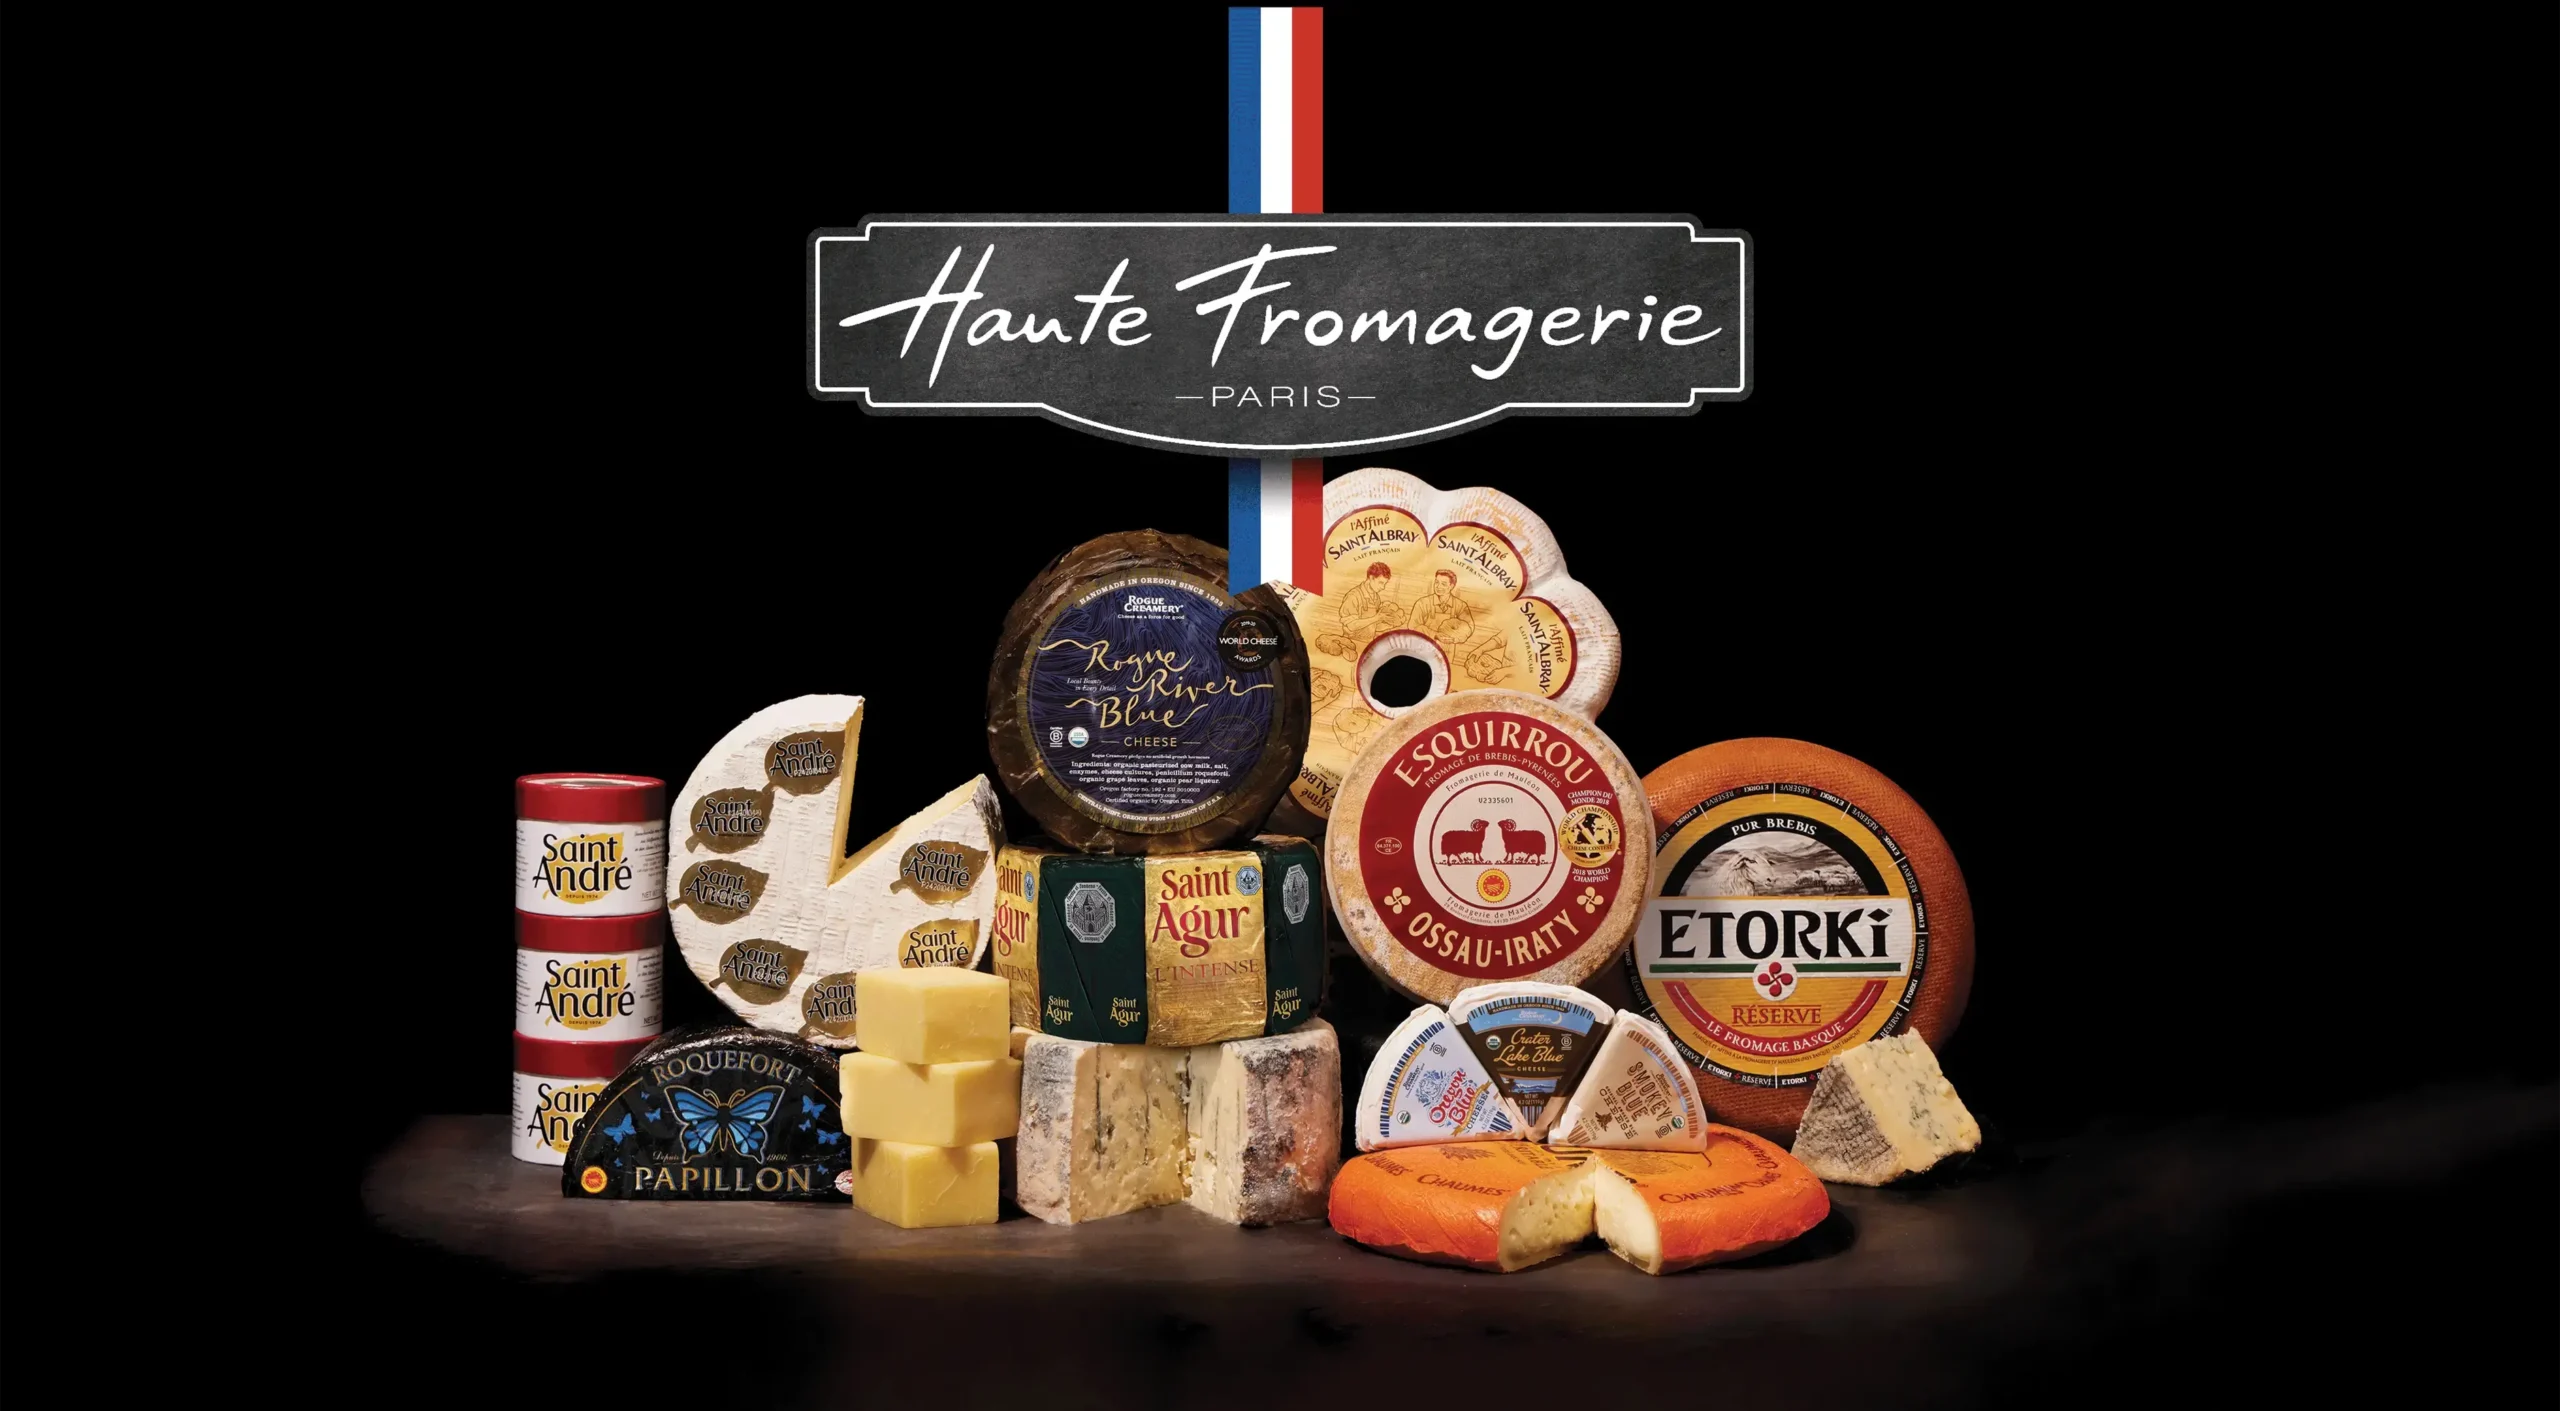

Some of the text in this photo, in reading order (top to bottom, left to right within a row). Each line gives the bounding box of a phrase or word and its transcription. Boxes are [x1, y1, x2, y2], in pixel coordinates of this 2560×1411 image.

[1350, 514, 1390, 531] l'Affiné
[1328, 529, 1419, 560] SAINT ALBRAY
[1353, 553, 1367, 562] LAIT
[1471, 533, 1508, 561] l'Affiné
[1438, 535, 1517, 589] SAINT ALBRAY
[1451, 558, 1465, 568] LAIT
[1079, 580, 1125, 605] HANDMADE
[1127, 578, 1138, 586] IN
[1140, 577, 1177, 586] OREGON
[1178, 582, 1205, 596] SINCE
[1128, 595, 1164, 606] ROGUE
[1124, 602, 1181, 613] CREAMERY
[1219, 637, 1278, 646] WORLD CHEESE
[1520, 601, 1552, 693] SAINT ALBRAY
[1549, 624, 1567, 663] l'Affiné
[1038, 639, 1194, 683] Rogue
[1234, 654, 1262, 663] AWARDS
[1126, 668, 1274, 703] River
[1065, 694, 1209, 728] Blue
[775, 738, 824, 757] Saint
[1124, 737, 1177, 748] CHEESE
[1393, 720, 1593, 788] ESQUIRROU
[769, 749, 836, 777] André
[1071, 761, 1112, 769] Ingredients:
[1424, 758, 1466, 788] FROMAGE
[1468, 753, 1481, 762] DE
[1300, 764, 1335, 795] ALBR
[1445, 769, 1541, 792] Fromagerie de Mauléon
[705, 797, 752, 815] Saint
[1299, 788, 1332, 813] Affiné
[1567, 790, 1613, 800] CHAMPION DU
[1571, 797, 1610, 805] MONDE 2018
[1561, 806, 1619, 836] WORLD CHAMPIONSHIP
[1731, 818, 1817, 836] PUR BREBIS
[543, 833, 618, 862] Saint
[916, 844, 963, 868] Saint
[532, 855, 632, 897] André
[698, 865, 745, 890] Saint
[903, 857, 970, 887] André
[999, 859, 1023, 898] aint
[1161, 865, 1231, 901] Saint
[1573, 874, 1609, 883] CHAMPION
[1587, 867, 1610, 876] WORLD
[685, 877, 752, 910] André
[1446, 896, 1491, 919] Fromagerie
[1508, 896, 1541, 917] Mauléon
[1916, 902, 1925, 928] ETORKI
[910, 929, 957, 949] Saint
[993, 900, 1029, 957] gur
[1152, 902, 1250, 958] Agur
[1408, 908, 1579, 968] OSSAU-IRATY
[736, 942, 782, 969] Saint
[903, 941, 968, 968] André
[546, 959, 621, 988] Saint
[722, 954, 789, 986] André
[1154, 959, 1260, 982] L'INTENSE
[535, 981, 635, 1024] André
[814, 980, 857, 999] Sain
[1048, 995, 1070, 1009] Saint
[1275, 987, 1298, 1001] Saint
[1903, 979, 1919, 1004] ETORKI
[807, 997, 857, 1023] And
[1046, 1004, 1073, 1025] Agur
[1112, 997, 1137, 1009] Saint
[1272, 999, 1301, 1020] Agur
[1732, 1004, 1822, 1026] RÉSERVE
[1110, 1007, 1141, 1028] Agur
[1511, 1028, 1551, 1045] Crater
[1706, 1021, 1721, 1037] LE
[1724, 1031, 1790, 1053] FROMAGE
[1793, 1022, 1845, 1050] BASQUE
[650, 1050, 803, 1085] ROQUEFORT
[1494, 1045, 1563, 1067] Lake Blue
[1707, 1064, 1732, 1078] ETORKI
[1781, 1076, 1807, 1086] ETORKI
[538, 1083, 600, 1113] Sain
[1429, 1070, 1467, 1124] Oregon
[1615, 1081, 1649, 1123] BLUE
[1626, 1061, 1673, 1122] SMOKEY
[1448, 1086, 1477, 1126] Blue
[1467, 1090, 1490, 1130] CHEESE
[1599, 1088, 1635, 1140] CHEESE
[766, 1153, 788, 1162] 1906
[634, 1166, 810, 1192] PAPILLON
[1417, 1173, 1504, 1197] CHAUMES
